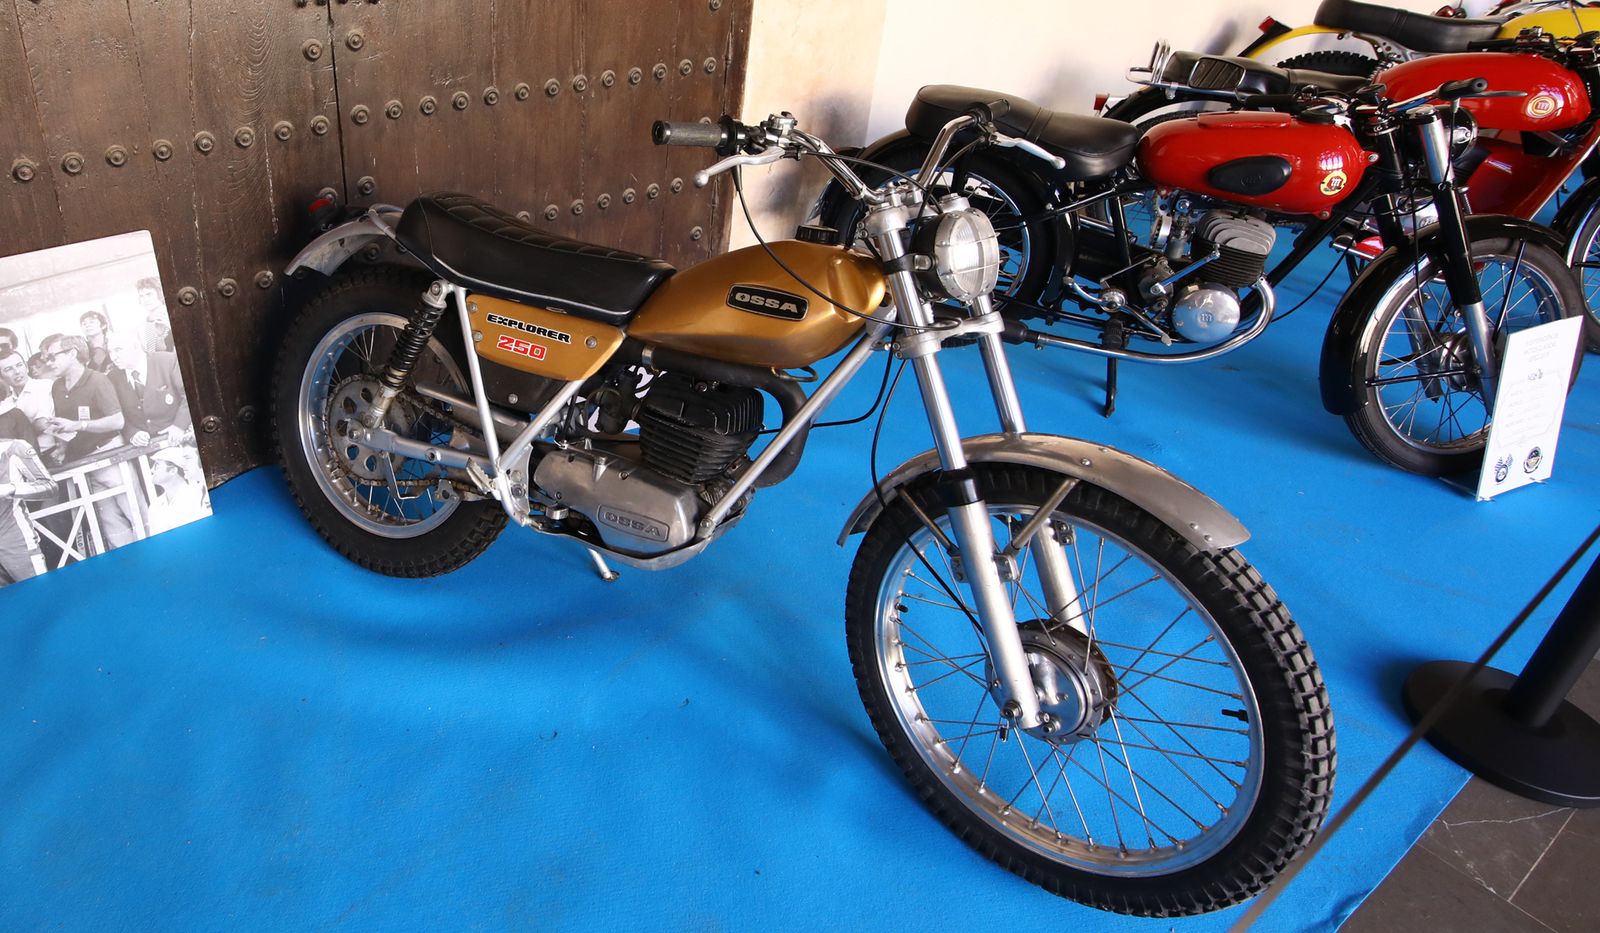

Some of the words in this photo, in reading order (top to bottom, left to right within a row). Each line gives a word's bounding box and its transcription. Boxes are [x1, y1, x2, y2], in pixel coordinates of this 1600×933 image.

[735, 292, 798, 313] OSSA
[486, 313, 571, 344] EXPLORER
[497, 335, 547, 360] 250
[604, 511, 661, 537] OSSA
